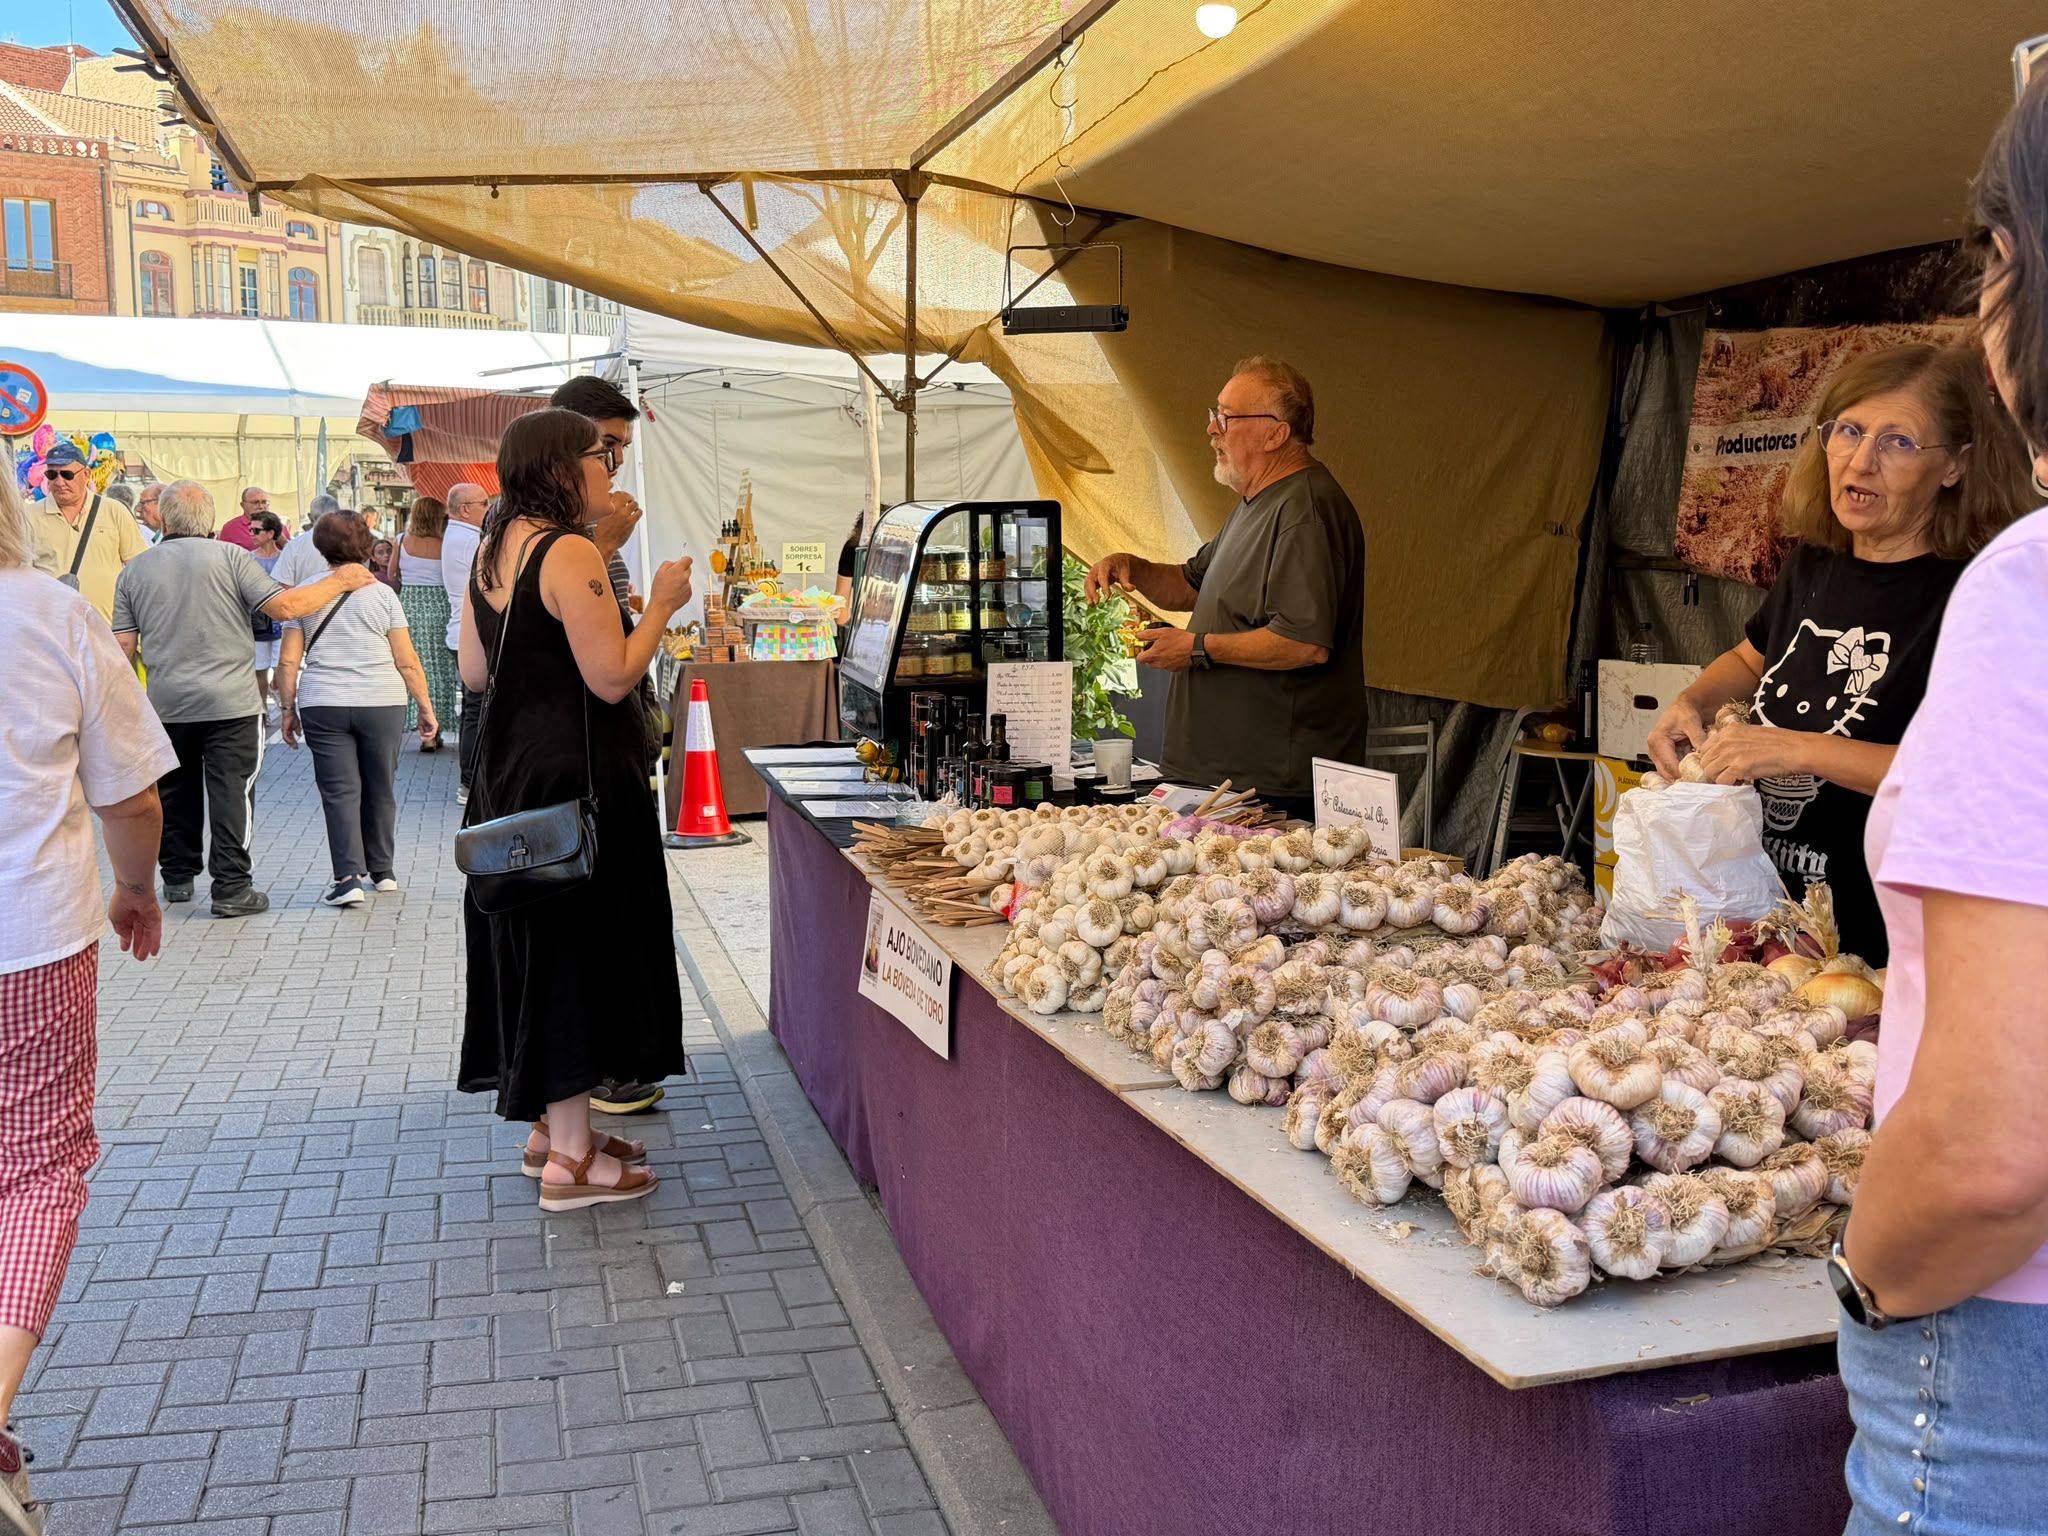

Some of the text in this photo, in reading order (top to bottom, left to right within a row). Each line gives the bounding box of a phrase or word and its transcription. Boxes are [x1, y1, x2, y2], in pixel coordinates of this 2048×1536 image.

[1715, 433, 1797, 456] Productores
[887, 926, 905, 956] AJO
[906, 936, 943, 987] BOVEDANO
[882, 962, 892, 984] LA
[892, 967, 917, 1001] BÓVEDA
[924, 994, 944, 1025] TORO
